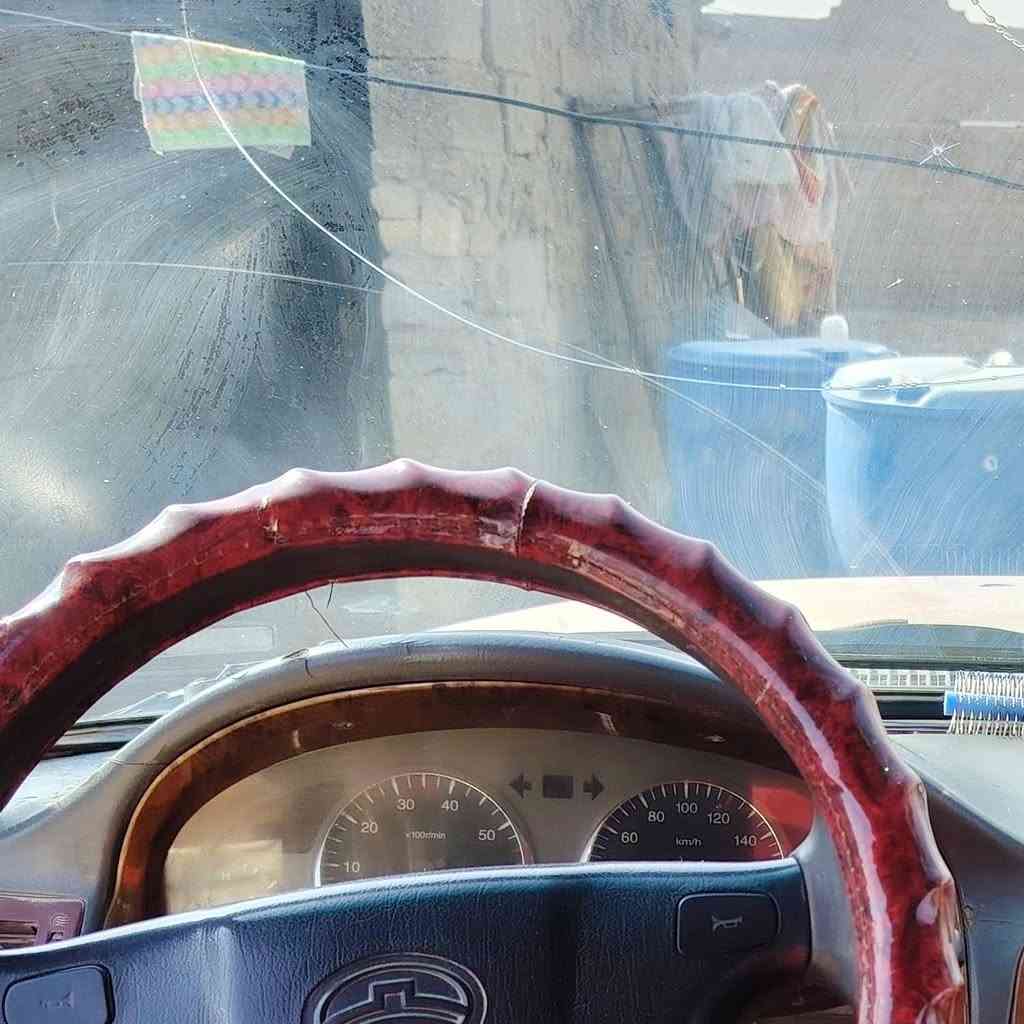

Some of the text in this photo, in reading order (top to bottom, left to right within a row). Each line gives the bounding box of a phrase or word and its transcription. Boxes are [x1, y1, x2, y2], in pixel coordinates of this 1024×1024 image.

[397, 798, 415, 811] 30
[441, 799, 459, 812] 40
[675, 802, 698, 814] 100
[648, 810, 665, 823] 80
[707, 812, 730, 825] 120
[360, 821, 378, 834] 20
[478, 829, 496, 842] 50
[621, 831, 638, 844] 60
[675, 836, 702, 847] km/h
[734, 835, 757, 847] 140
[343, 861, 360, 874] 10
